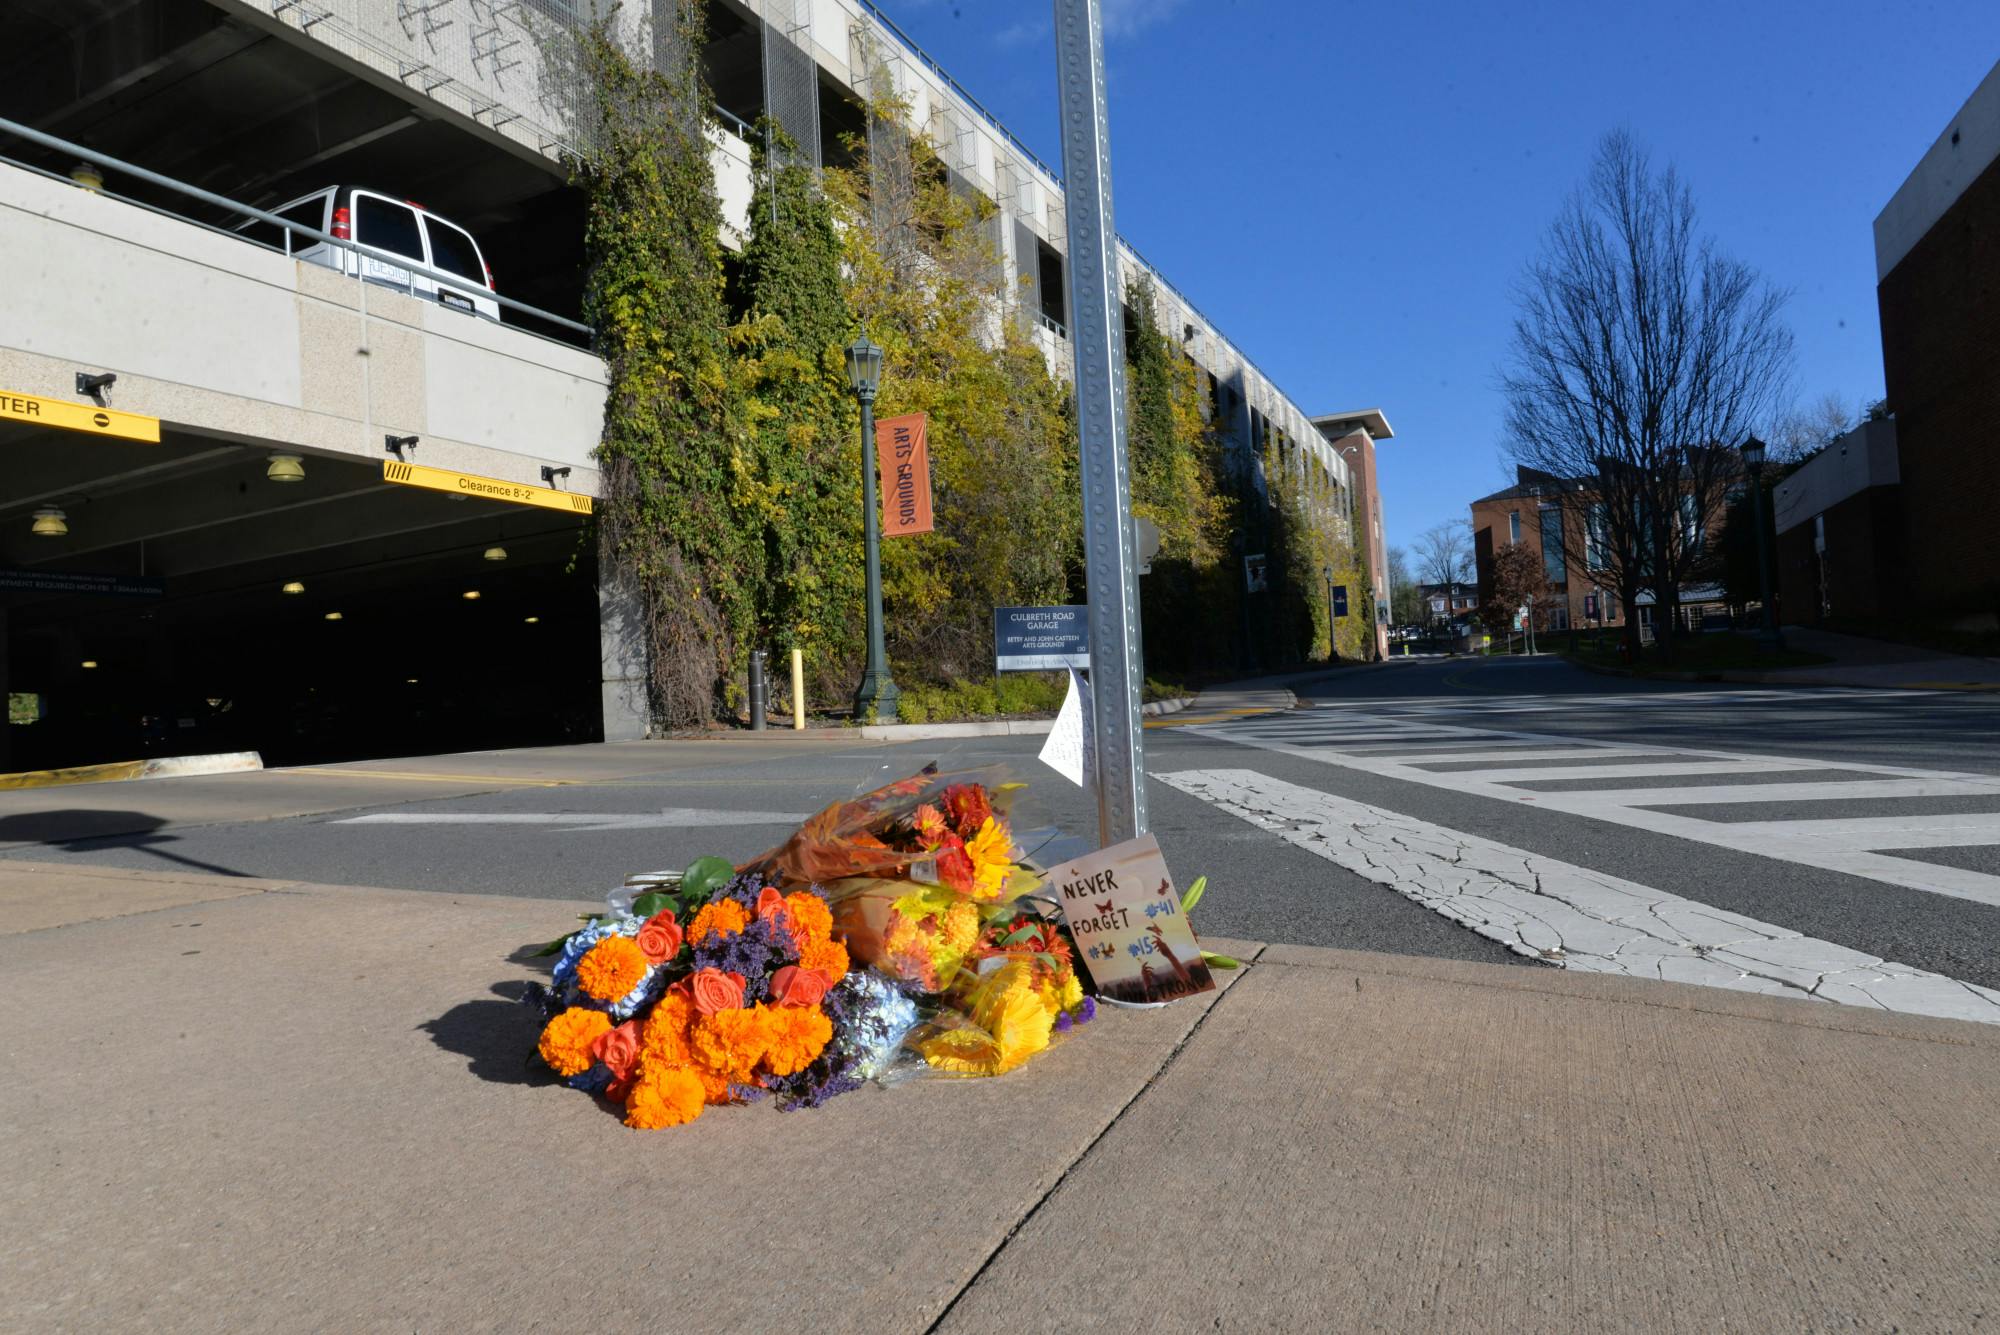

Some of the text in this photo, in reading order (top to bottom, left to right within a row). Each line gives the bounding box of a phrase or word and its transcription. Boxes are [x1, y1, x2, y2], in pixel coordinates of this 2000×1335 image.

[894, 427, 912, 458] ARTS
[458, 478, 511, 497] Clearance
[896, 463, 916, 526] GROUNDS
[1010, 611, 1075, 622] CULBRETH ROAD
[1027, 621, 1059, 630] GARAGE
[1036, 641, 1065, 649] GROUNDS
[1037, 635, 1054, 643] JOHN
[1054, 634, 1080, 642] CASTEEN
[1063, 869, 1119, 899] NEVER
[1144, 899, 1175, 919] #41
[1072, 908, 1130, 936] FORGET
[1128, 937, 1154, 957] #15
